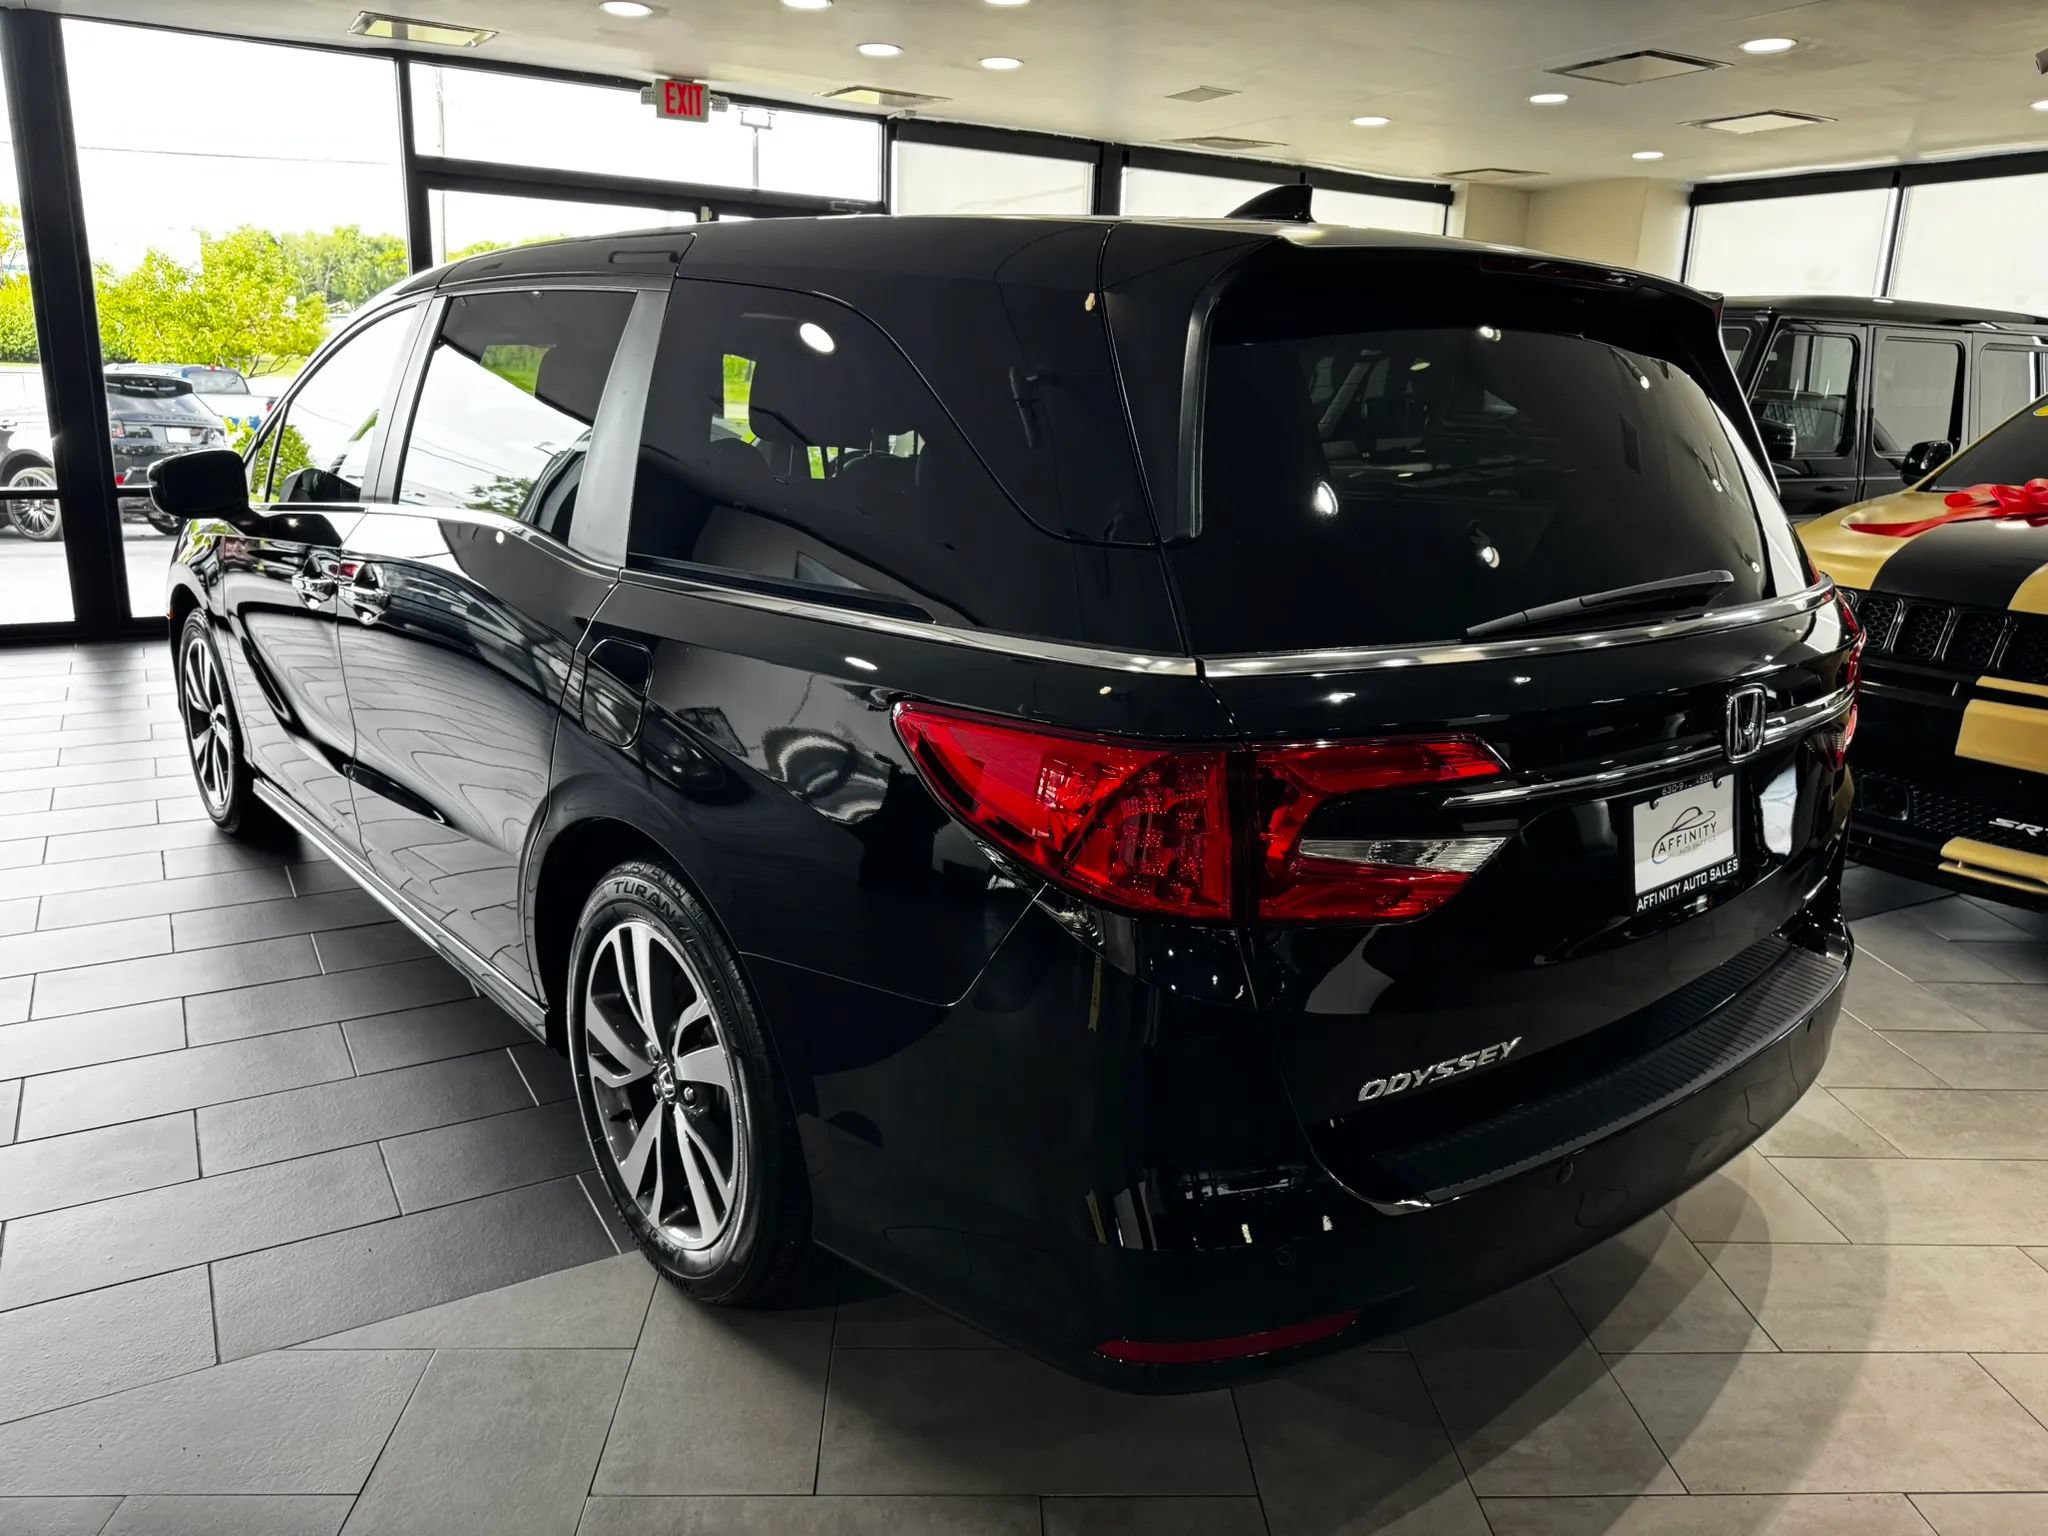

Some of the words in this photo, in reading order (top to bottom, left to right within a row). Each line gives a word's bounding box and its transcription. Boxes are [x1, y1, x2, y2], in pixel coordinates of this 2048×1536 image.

[665, 82, 704, 117] EXIT
[1658, 821, 1717, 854] AFFINITY
[1989, 818, 2048, 836] SR
[1636, 882, 1681, 912] AFFINITY
[1683, 872, 1708, 894] AUTO
[1710, 858, 1739, 882] SALES
[1358, 1036, 1522, 1102] ODYSSEY
